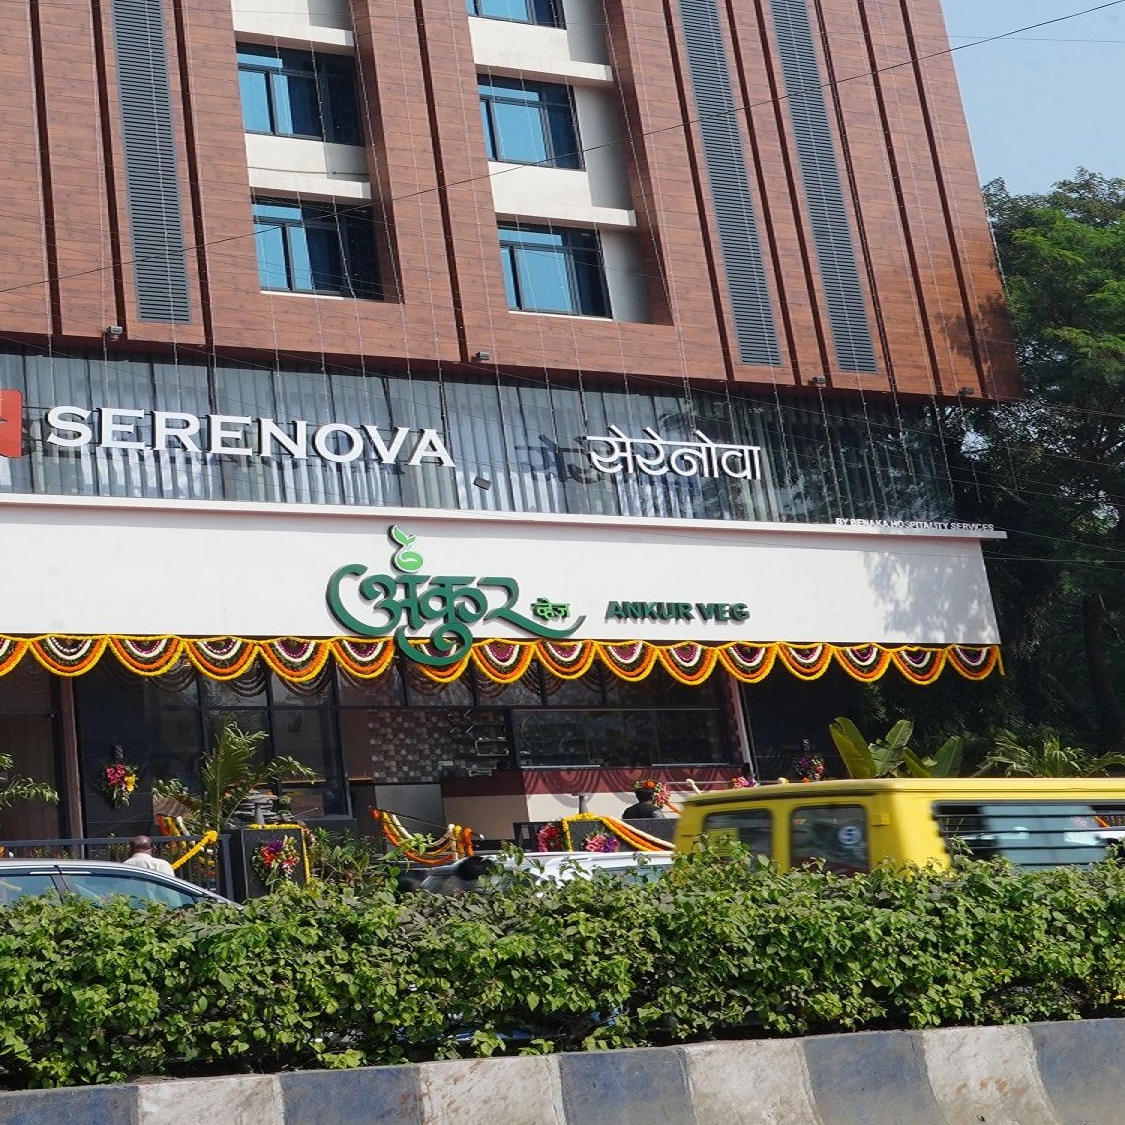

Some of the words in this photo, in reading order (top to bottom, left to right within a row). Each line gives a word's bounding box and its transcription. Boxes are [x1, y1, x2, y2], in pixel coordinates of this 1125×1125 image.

[46, 405, 456, 467] SERENOVA
[586, 424, 761, 480] सेरेनोवा
[835, 517, 848, 526] BY
[890, 520, 949, 530] HOSPITALITY
[950, 522, 994, 532] SERVICES
[326, 524, 586, 665] अंकुर
[606, 601, 694, 621] ANKUR
[696, 602, 750, 622] VEG
